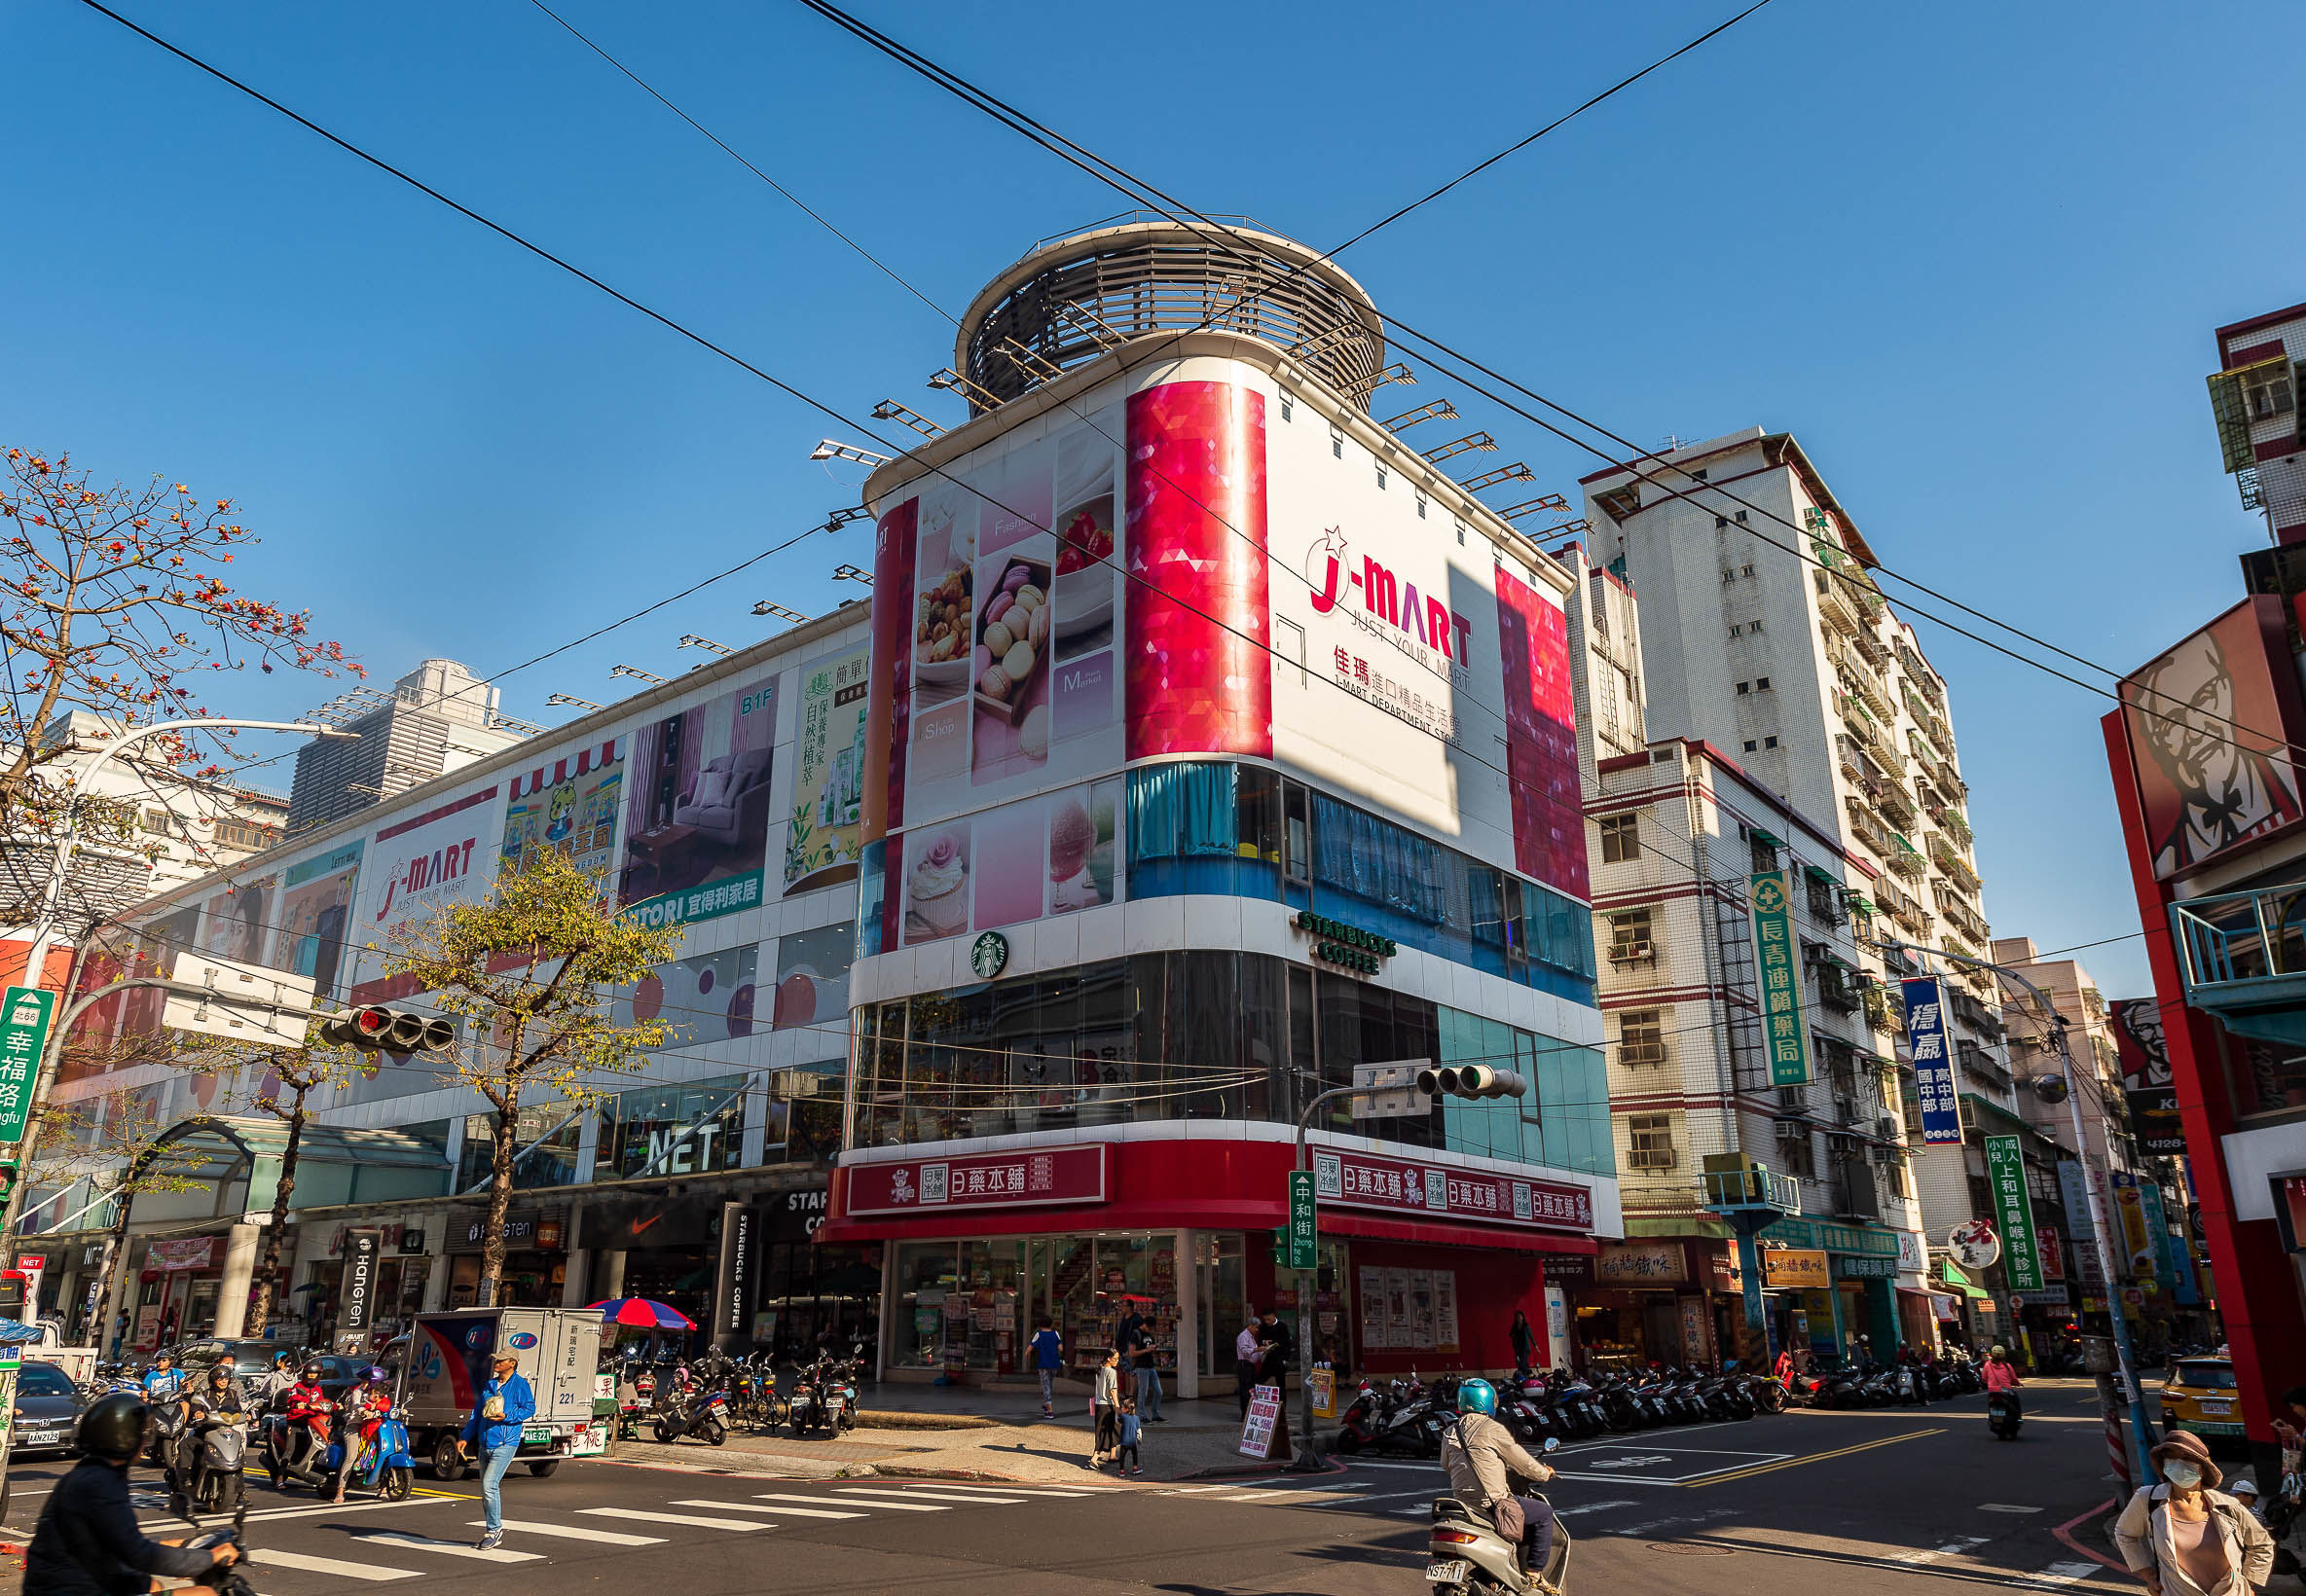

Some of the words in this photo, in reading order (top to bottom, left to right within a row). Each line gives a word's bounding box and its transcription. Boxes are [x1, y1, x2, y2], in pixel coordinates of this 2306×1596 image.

[1351, 609, 1385, 642] JUST
[1394, 633, 1429, 667] YOUR
[1437, 659, 1470, 693] MART
[837, 655, 869, 685] 簡單
[741, 686, 773, 716] B1F
[926, 722, 955, 741] Shop
[397, 896, 415, 911] JUST
[443, 879, 467, 895] MART
[688, 878, 757, 916] 宜得利家居
[1298, 911, 1397, 958] STARBUCKS
[1317, 942, 1379, 975] COFFEE
[1762, 920, 1799, 1063] 長青連鎖藥局
[0, 1030, 34, 1108] 幸福路
[1918, 1070, 1937, 1113] 國中部
[1935, 1068, 1955, 1112] 高中部
[646, 1123, 720, 1176] NET
[1989, 1141, 2003, 1163] 小兒
[2004, 1139, 2020, 1163] 成人
[952, 1166, 1025, 1194] 日藥本舖
[1344, 1167, 1401, 1198] 日藥本舖
[1448, 1182, 1496, 1209] 日藥本舖
[1297, 1185, 1311, 1236] 中和街
[1533, 1193, 1575, 1217] 日藥本舖
[2000, 1165, 2033, 1288] 上和耳鼻喉科診所
[735, 1215, 748, 1282] STARBUCKS
[1844, 1257, 1896, 1278] 健保藥局
[732, 1287, 742, 1328] COFFEE
[559, 1393, 574, 1404] 221
